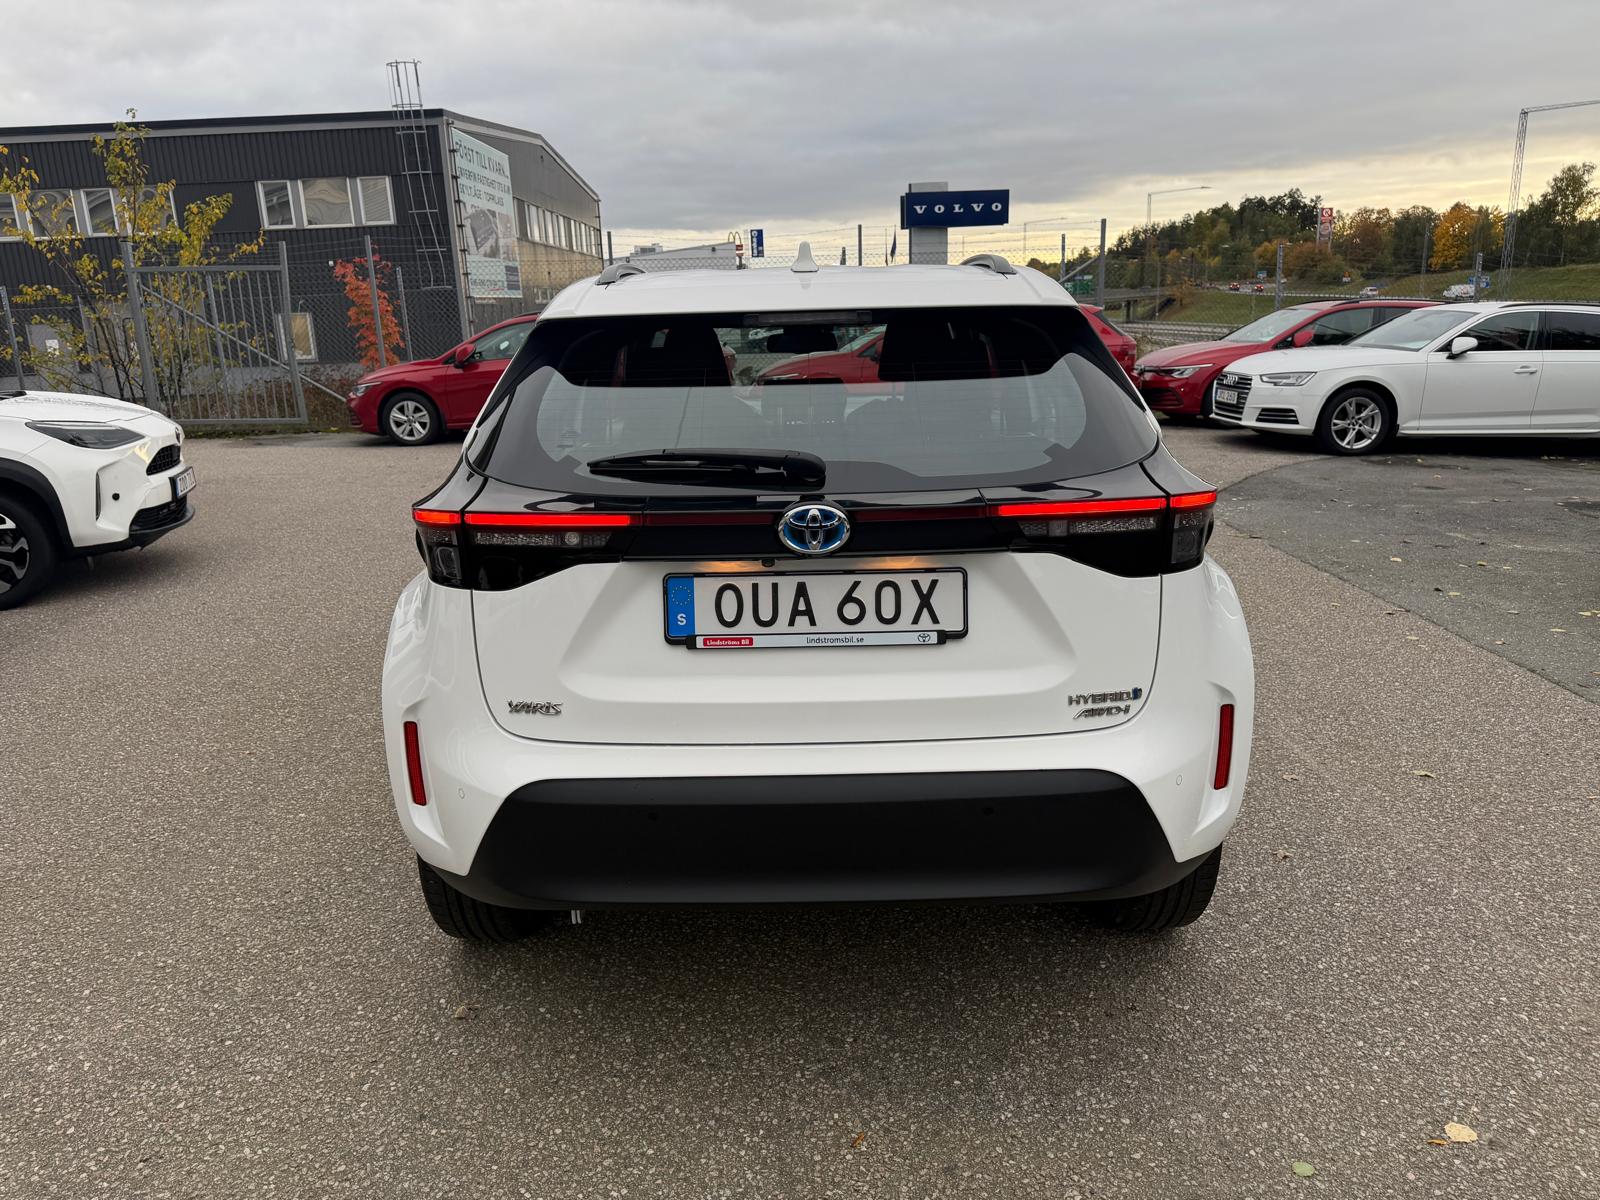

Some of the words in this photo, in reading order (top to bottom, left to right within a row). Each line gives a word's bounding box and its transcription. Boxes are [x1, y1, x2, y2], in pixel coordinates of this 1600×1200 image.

[913, 202, 1002, 214] VOLVO
[677, 613, 687, 626] S
[715, 582, 817, 628] OUA
[837, 579, 940, 626] 60X
[706, 637, 740, 646] Lindströms
[741, 637, 750, 646] Bil
[806, 636, 865, 645] lindstromsbil.se
[1068, 690, 1131, 706] HYBRID
